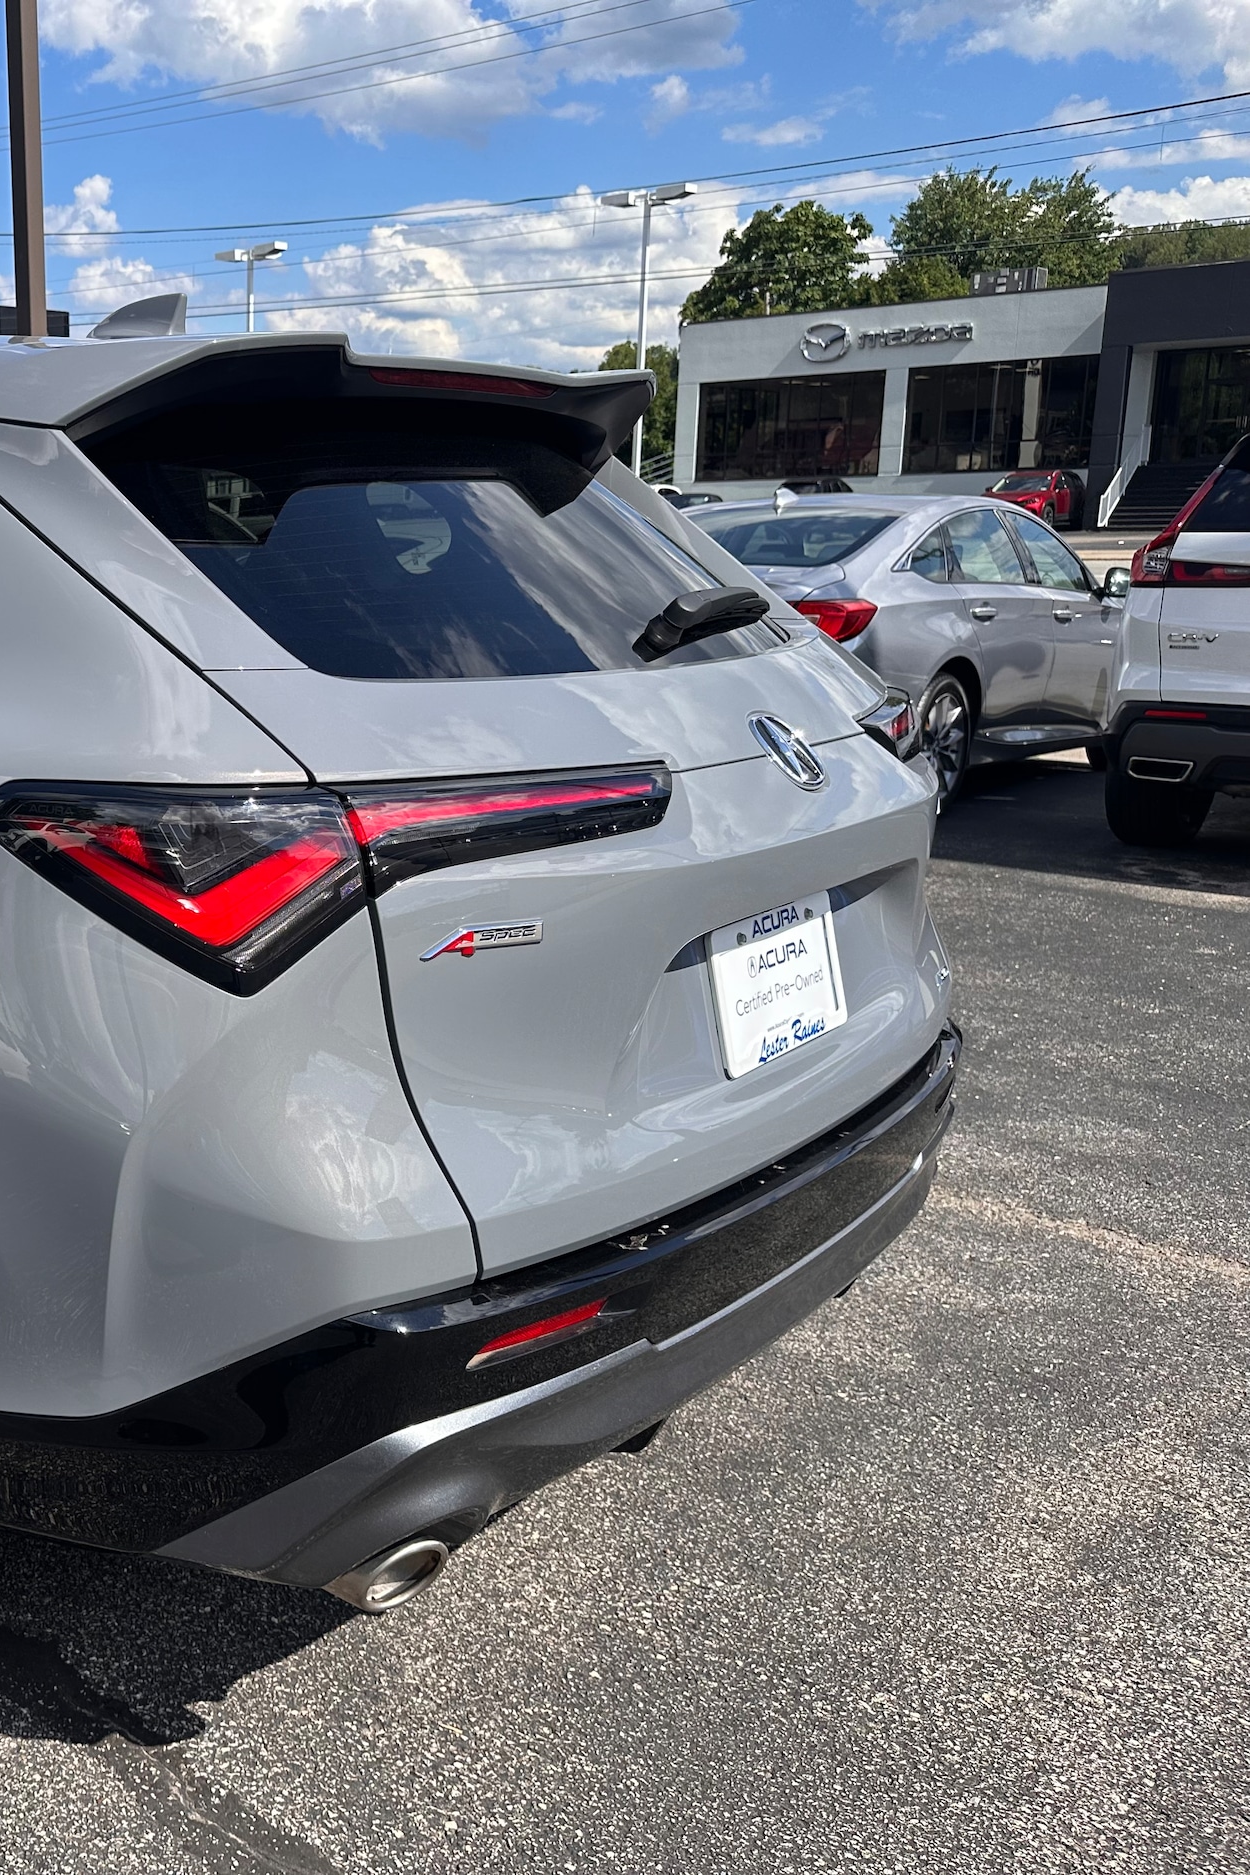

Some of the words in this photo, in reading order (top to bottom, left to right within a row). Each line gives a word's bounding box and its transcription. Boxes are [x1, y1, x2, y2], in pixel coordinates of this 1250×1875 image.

[752, 906, 800, 938] ACURA
[758, 939, 808, 973] ACURA
[736, 986, 773, 1017] Certified
[775, 968, 824, 1001] Pre-Owned
[759, 1034, 790, 1063] Lester
[791, 1017, 826, 1045] Raines
